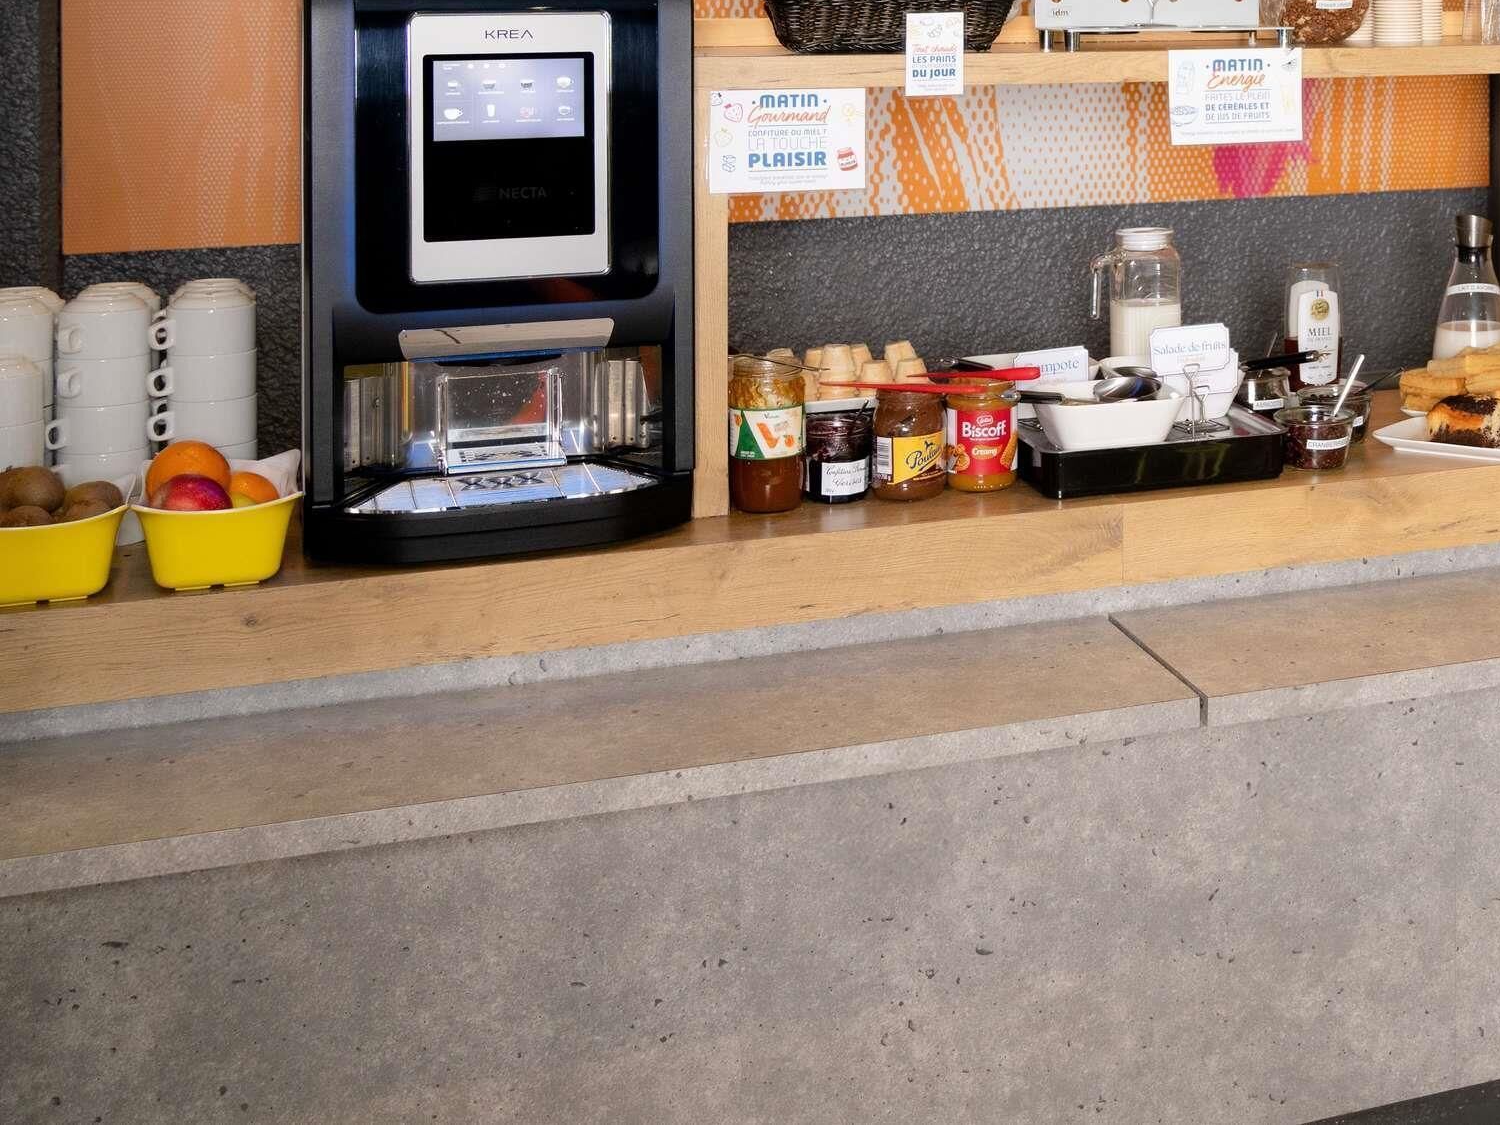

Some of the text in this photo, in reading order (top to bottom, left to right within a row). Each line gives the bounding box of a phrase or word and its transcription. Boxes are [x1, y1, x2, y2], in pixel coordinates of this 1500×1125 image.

[484, 29, 534, 40] KREA
[912, 55, 927, 64] LES
[1212, 58, 1263, 72] MATIN
[912, 68, 956, 79] DU JOUR
[759, 93, 819, 108] MATIN
[1205, 103, 1216, 112] DE
[1260, 102, 1269, 111] ET
[747, 105, 832, 129] Gourmand
[748, 129, 789, 137] CONFITURE
[748, 136, 828, 151] LA TOUCHE
[748, 151, 827, 168] PLAISIR
[499, 186, 548, 200] NECTA
[1308, 326, 1333, 336] MIEL
[1152, 342, 1185, 355] Salade
[1201, 340, 1226, 351] fruits
[1037, 359, 1080, 375] mpote
[962, 420, 1007, 438] Biscoff
